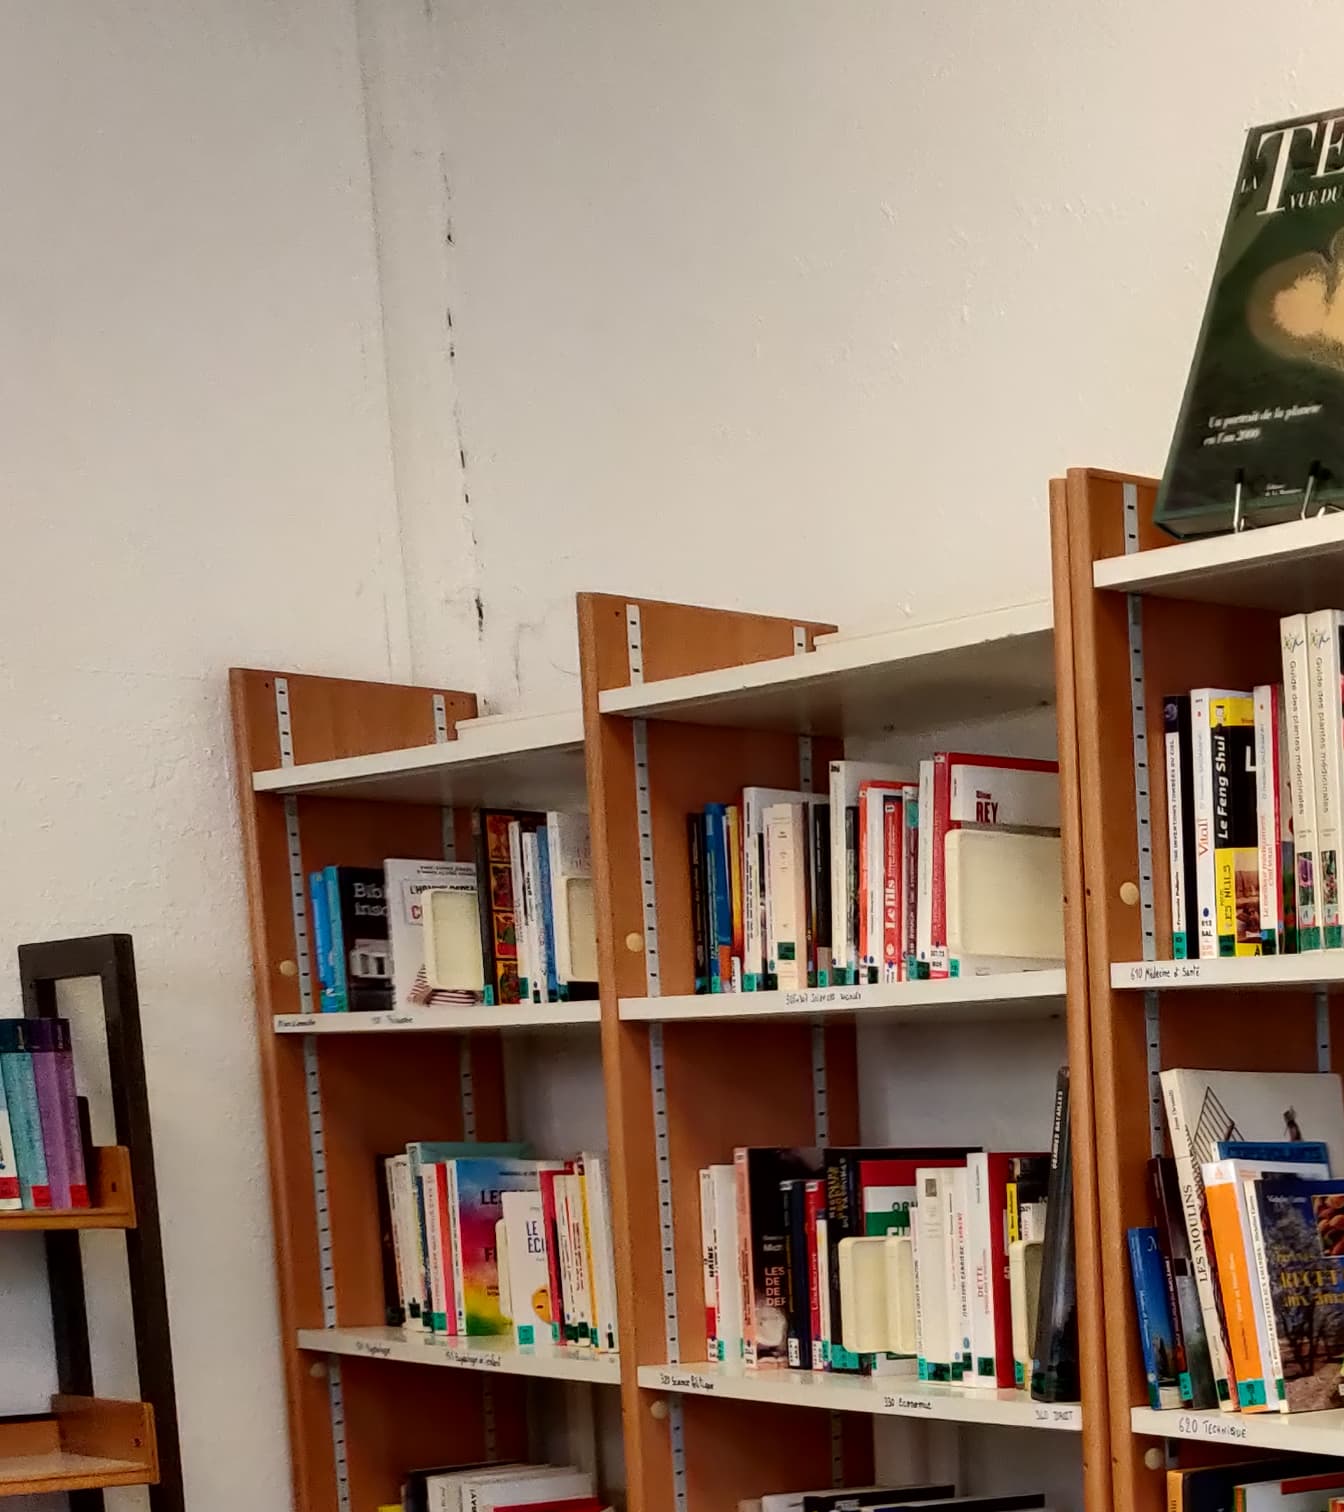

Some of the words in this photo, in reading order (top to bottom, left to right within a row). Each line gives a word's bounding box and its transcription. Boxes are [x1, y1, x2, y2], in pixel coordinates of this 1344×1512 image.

[1290, 190, 1320, 209] VUE
[1321, 188, 1341, 204] DU
[1214, 734, 1225, 773] Shui
[1217, 775, 1229, 816] Feng
[976, 802, 998, 823] REY
[1217, 819, 1229, 840] Le
[1182, 1183, 1207, 1256] MOULINS
[1177, 1417, 1199, 1435] 620
[1203, 1419, 1248, 1439] TECHNIQUE
